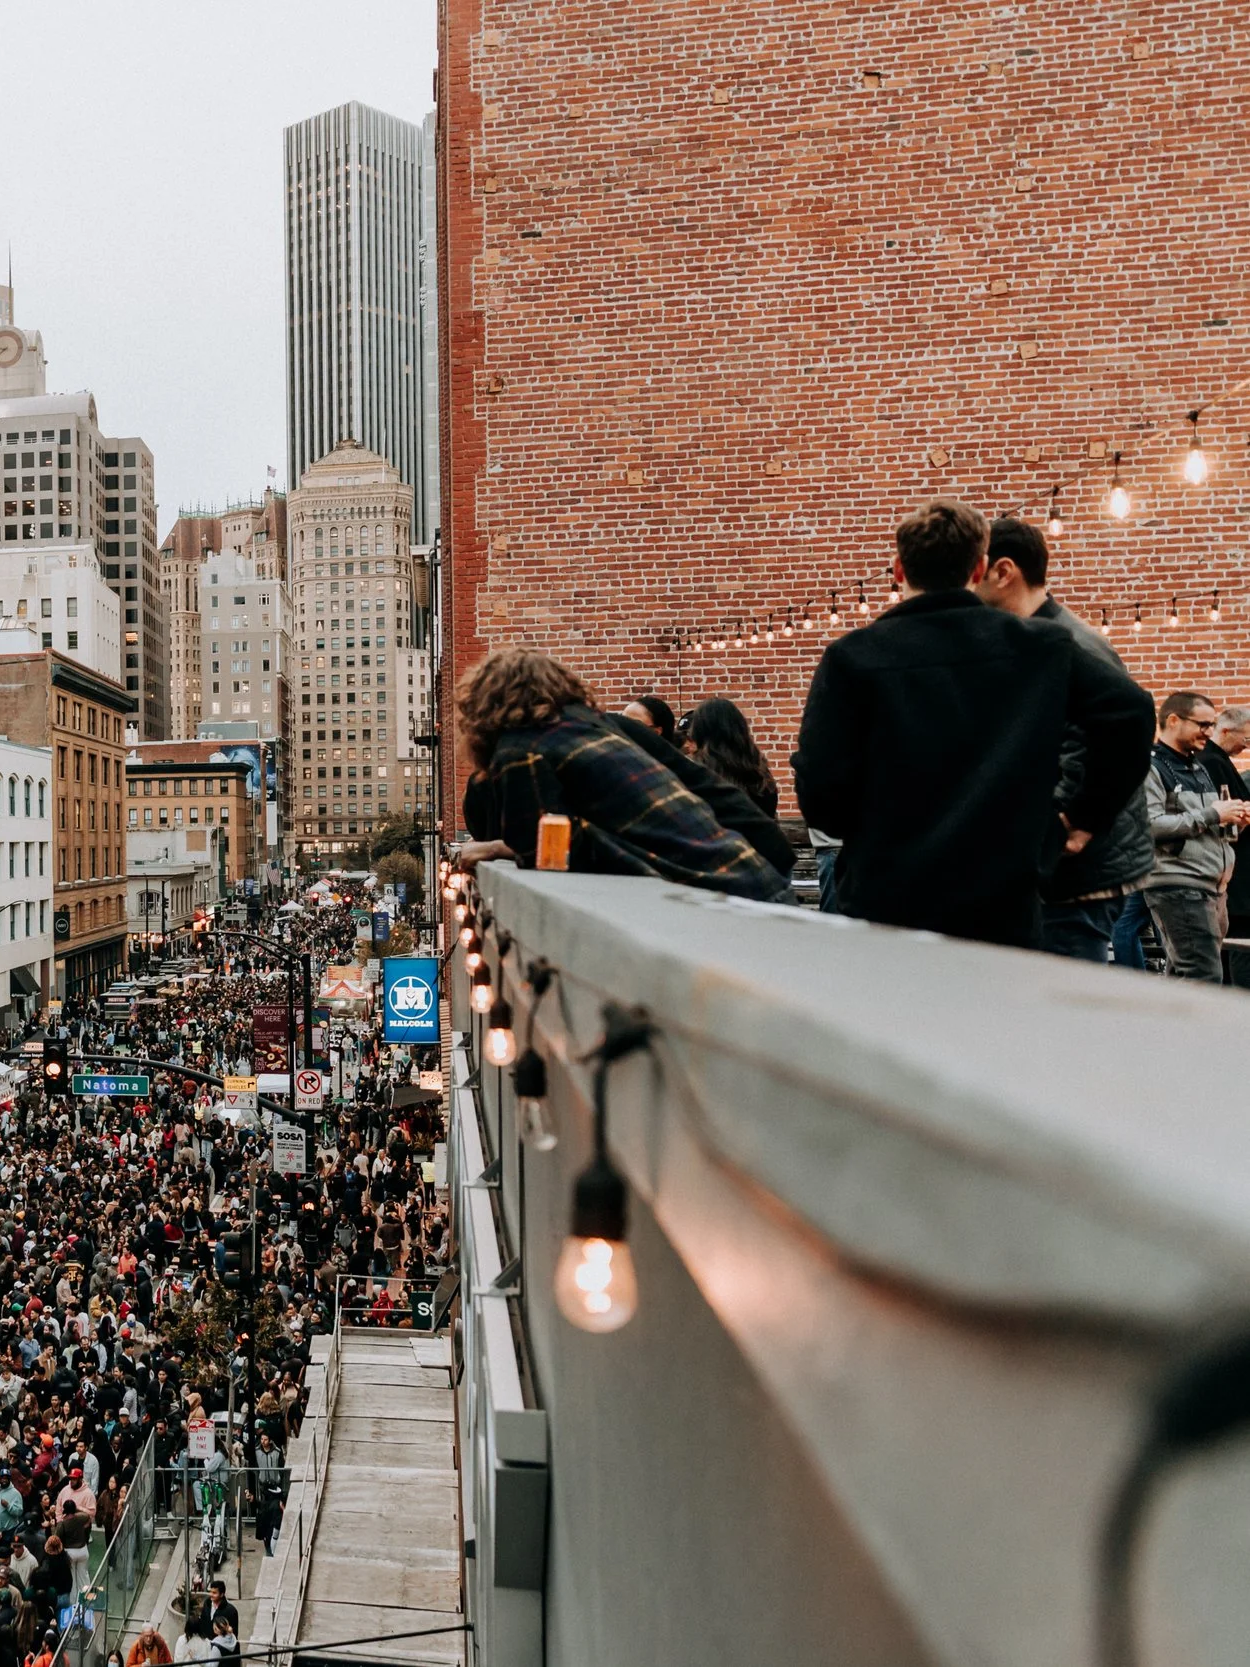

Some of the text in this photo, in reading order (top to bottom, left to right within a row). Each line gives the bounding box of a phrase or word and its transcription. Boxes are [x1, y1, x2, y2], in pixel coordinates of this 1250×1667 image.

[252, 1008, 286, 1016] DISCOVER
[389, 1020, 434, 1028] MALCOLM
[82, 1079, 139, 1091] Natoma
[297, 1097, 321, 1105] ON RED
[277, 1131, 304, 1142] SOSA
